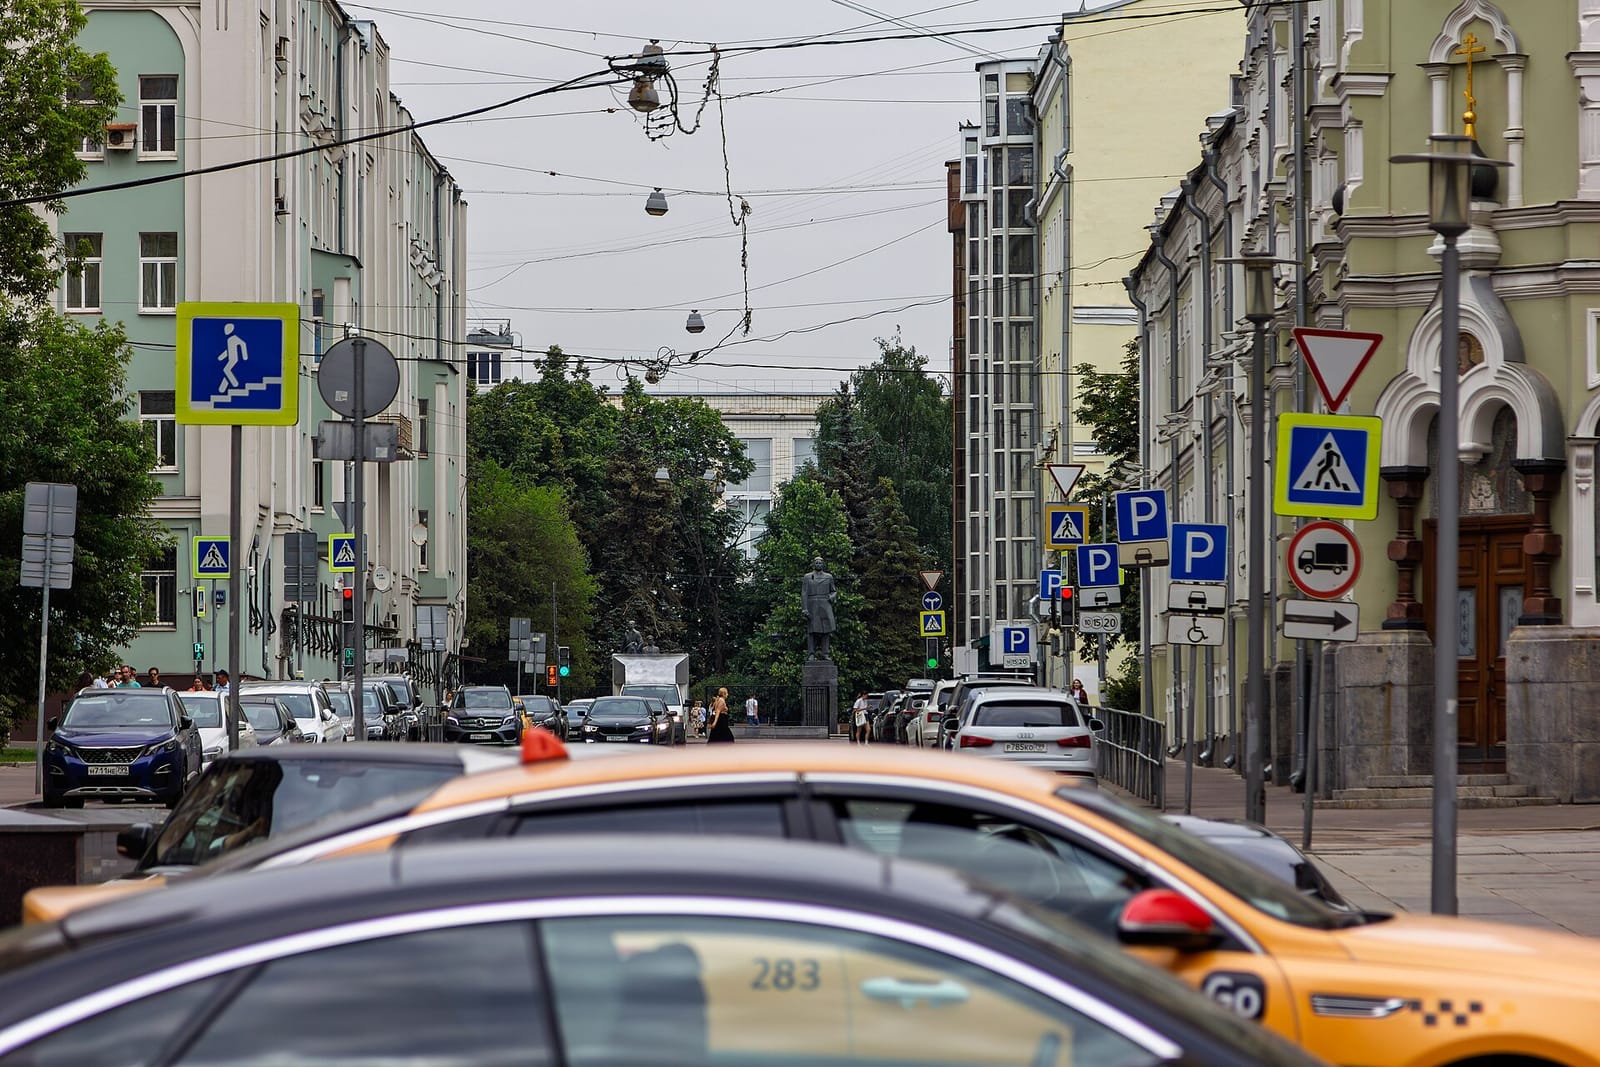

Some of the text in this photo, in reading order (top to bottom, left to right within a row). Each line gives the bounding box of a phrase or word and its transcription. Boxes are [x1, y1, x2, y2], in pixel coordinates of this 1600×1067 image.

[1131, 496, 1158, 536] P
[1185, 531, 1214, 573] P
[1089, 549, 1111, 582] P
[1048, 574, 1061, 595] P
[1093, 618, 1101, 627] 15
[1104, 618, 1116, 627] 20
[194, 643, 204, 653] 04
[1010, 630, 1025, 651] P
[749, 956, 820, 988] 283
